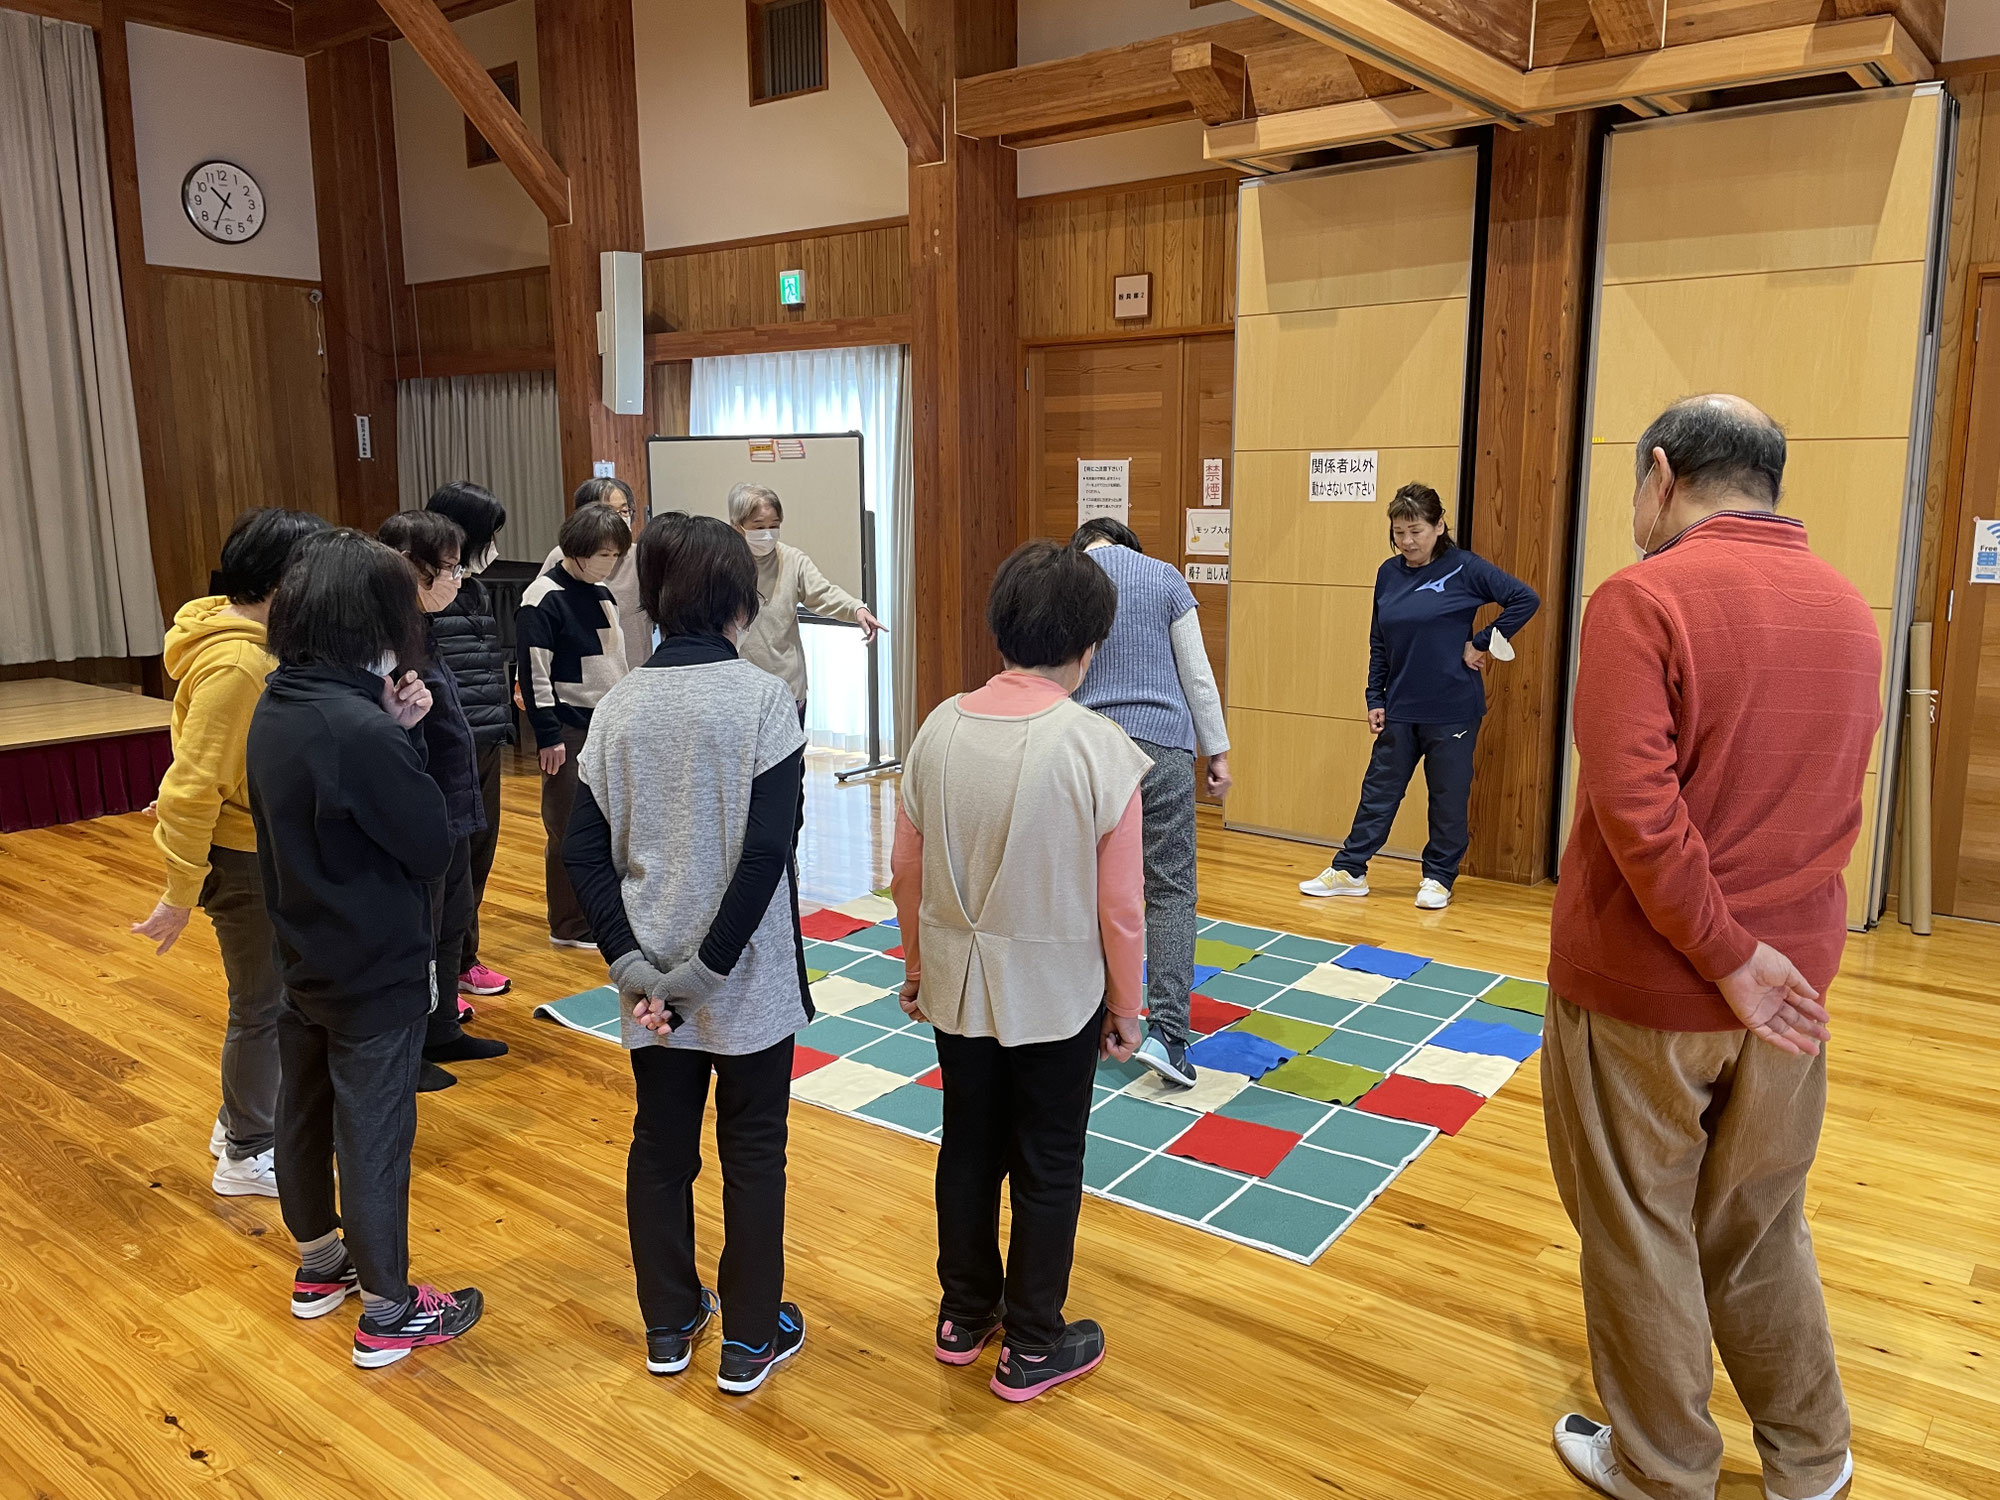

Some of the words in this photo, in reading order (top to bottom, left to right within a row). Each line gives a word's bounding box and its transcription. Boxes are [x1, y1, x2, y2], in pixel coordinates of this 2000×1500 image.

[205, 172, 214, 184] 11
[217, 170, 227, 181] 12
[233, 174, 238, 185] 1
[197, 181, 207, 193] 10
[242, 185, 251, 196] 2
[194, 195, 202, 206] 9
[248, 199, 255, 210] 3
[201, 210, 209, 221] 8
[246, 213, 253, 224] 4
[225, 224, 233, 235] 6
[237, 222, 245, 233] 5
[1311, 457, 1374, 474] 関係者以外
[1205, 464, 1220, 500] 禁煙
[1311, 481, 1375, 497] 動かさないで下さい
[1188, 566, 1200, 580] 椅子
